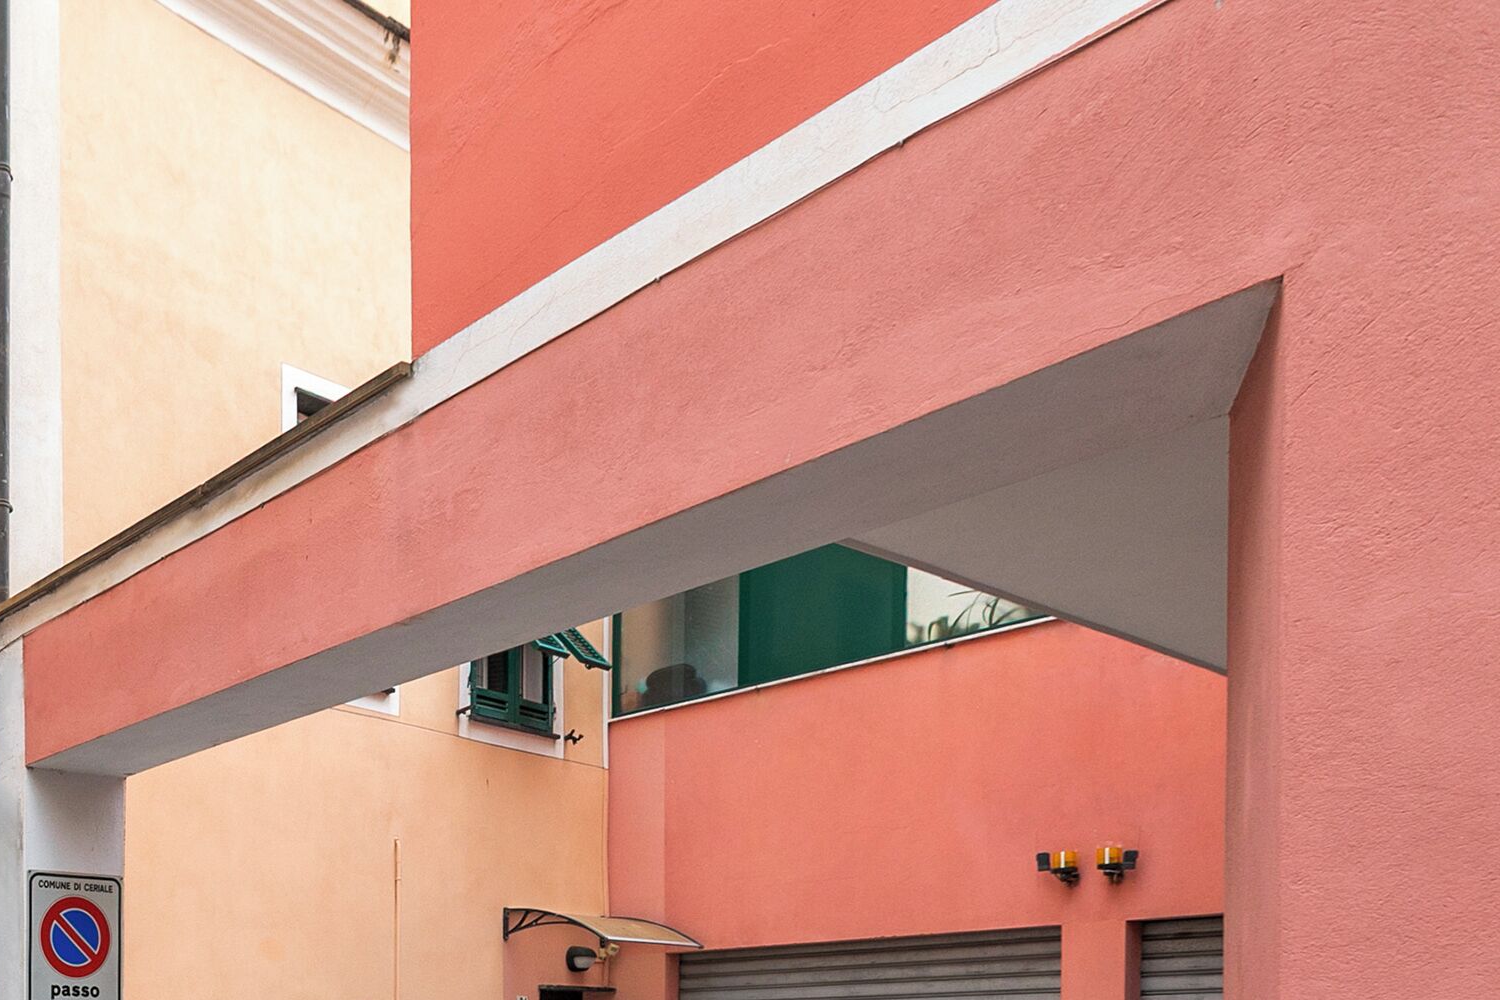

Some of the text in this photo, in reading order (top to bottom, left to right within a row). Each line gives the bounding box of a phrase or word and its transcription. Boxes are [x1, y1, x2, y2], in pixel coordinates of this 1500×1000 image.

[38, 880, 113, 893] COMUNE DI CERIALE
[51, 984, 100, 1000] passo
